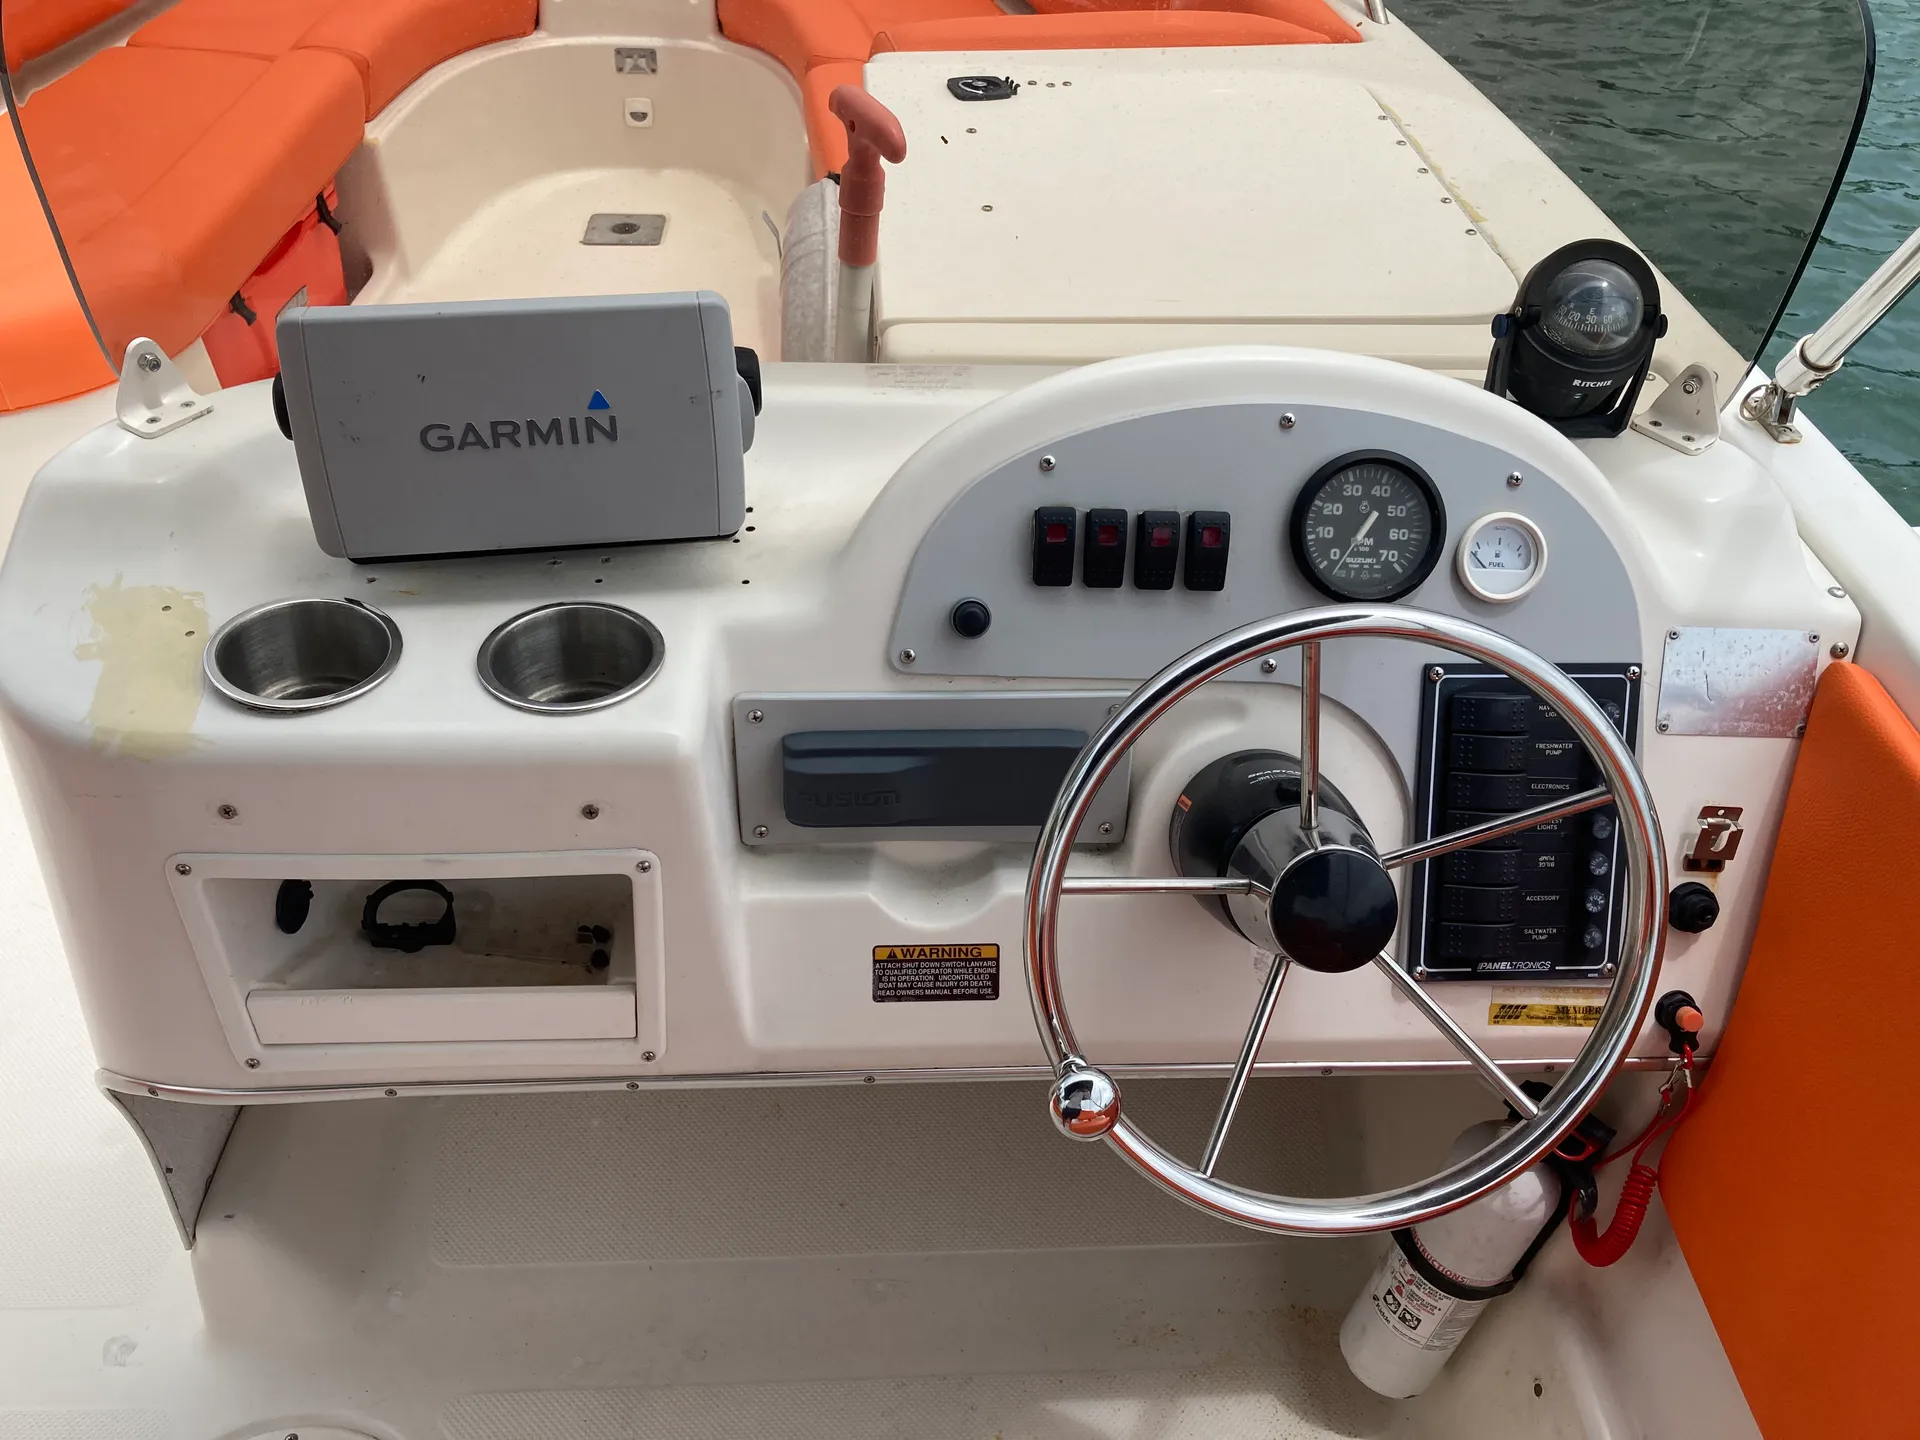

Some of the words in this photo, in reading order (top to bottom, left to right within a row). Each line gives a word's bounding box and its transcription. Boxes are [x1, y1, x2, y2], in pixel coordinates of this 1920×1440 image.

[1568, 311, 1580, 321] 120
[1585, 315, 1597, 324] 90
[1603, 315, 1613, 324] 60
[1572, 379, 1612, 388] RITCHIE
[420, 414, 618, 452] GARMIN
[1343, 485, 1362, 496] 30
[1371, 485, 1390, 497] 40
[1323, 503, 1342, 515] 20
[1387, 505, 1406, 517] 50
[1316, 527, 1334, 538] 10
[1389, 529, 1408, 540] 60
[1330, 548, 1340, 560] 0
[1379, 550, 1398, 561] 70
[900, 947, 982, 958] WARNING
[1478, 961, 1551, 970] PANELTRONICS
